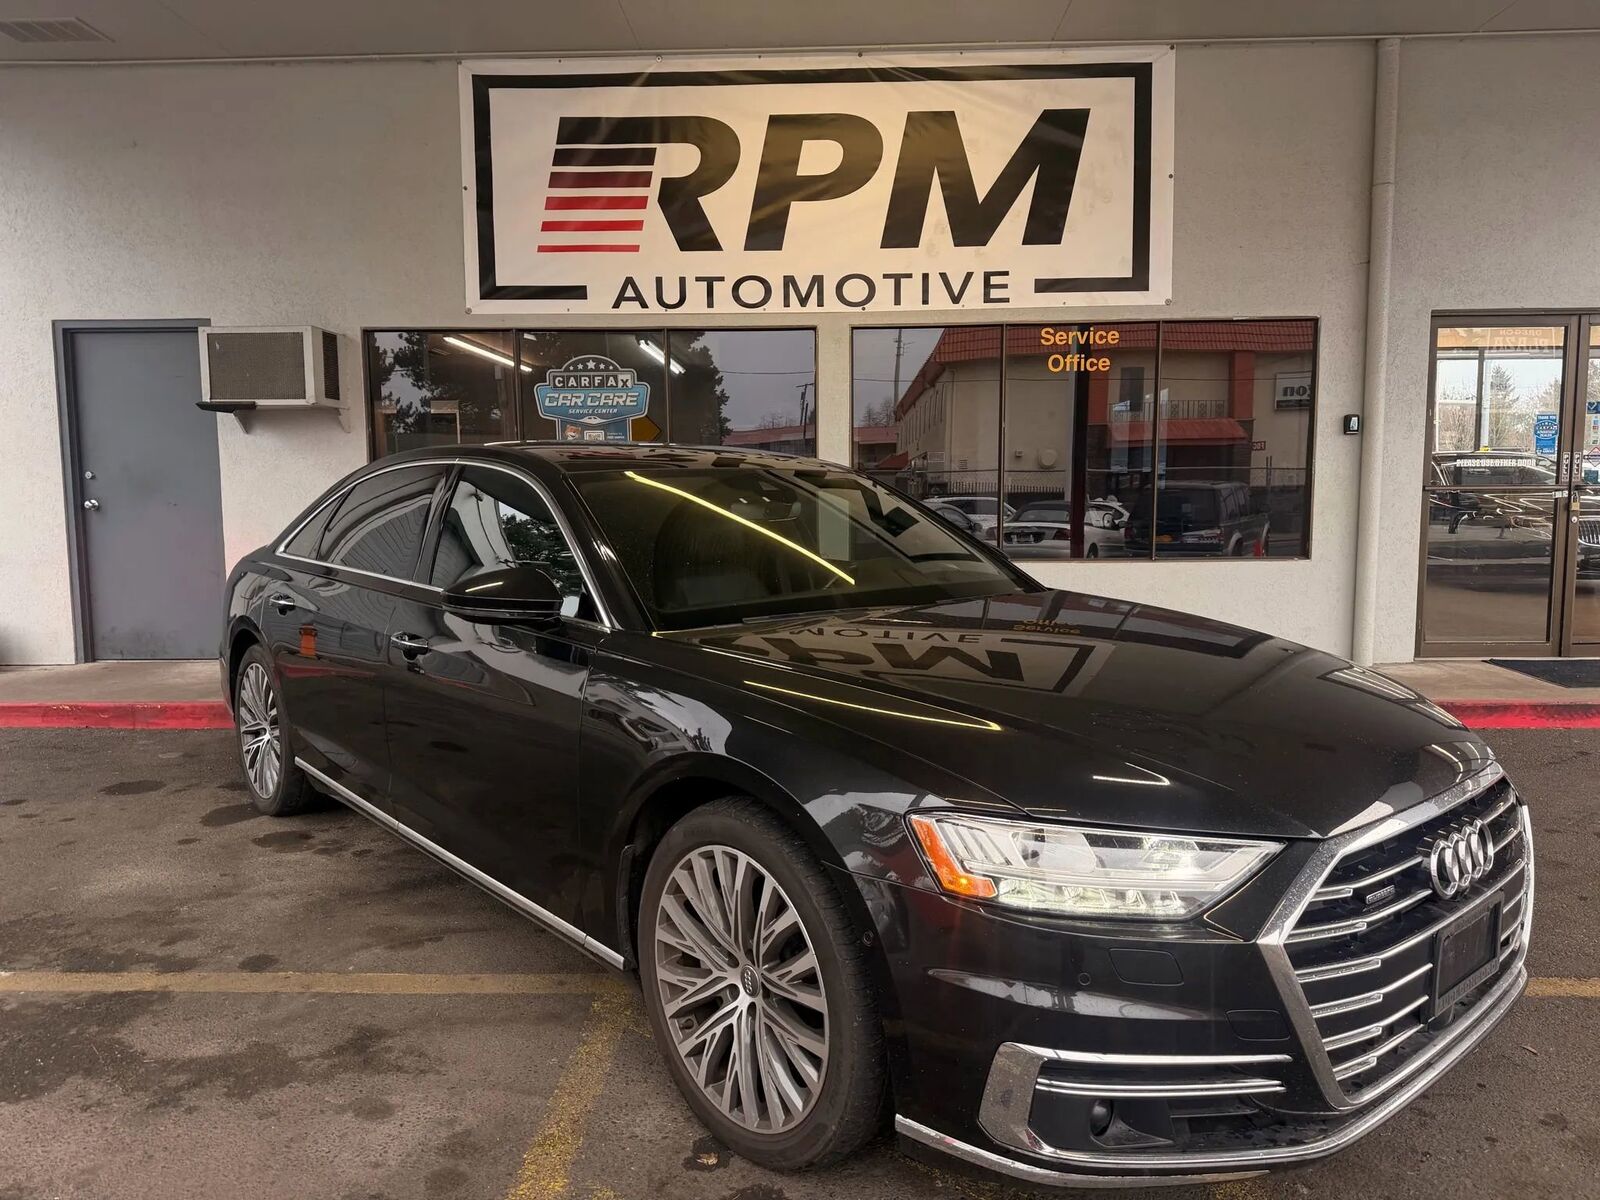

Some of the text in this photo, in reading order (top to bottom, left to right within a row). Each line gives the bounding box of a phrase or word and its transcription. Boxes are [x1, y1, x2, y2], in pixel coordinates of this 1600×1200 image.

[537, 108, 1091, 252] RPM
[612, 270, 1011, 310] AUTOMOTIVE
[1040, 327, 1120, 346] Service
[1047, 354, 1111, 373] Office
[555, 375, 632, 388] CARFAX
[544, 392, 639, 407] CAR CARE
[1456, 459, 1480, 467] PLEASE
[1517, 459, 1537, 467] DOOR
